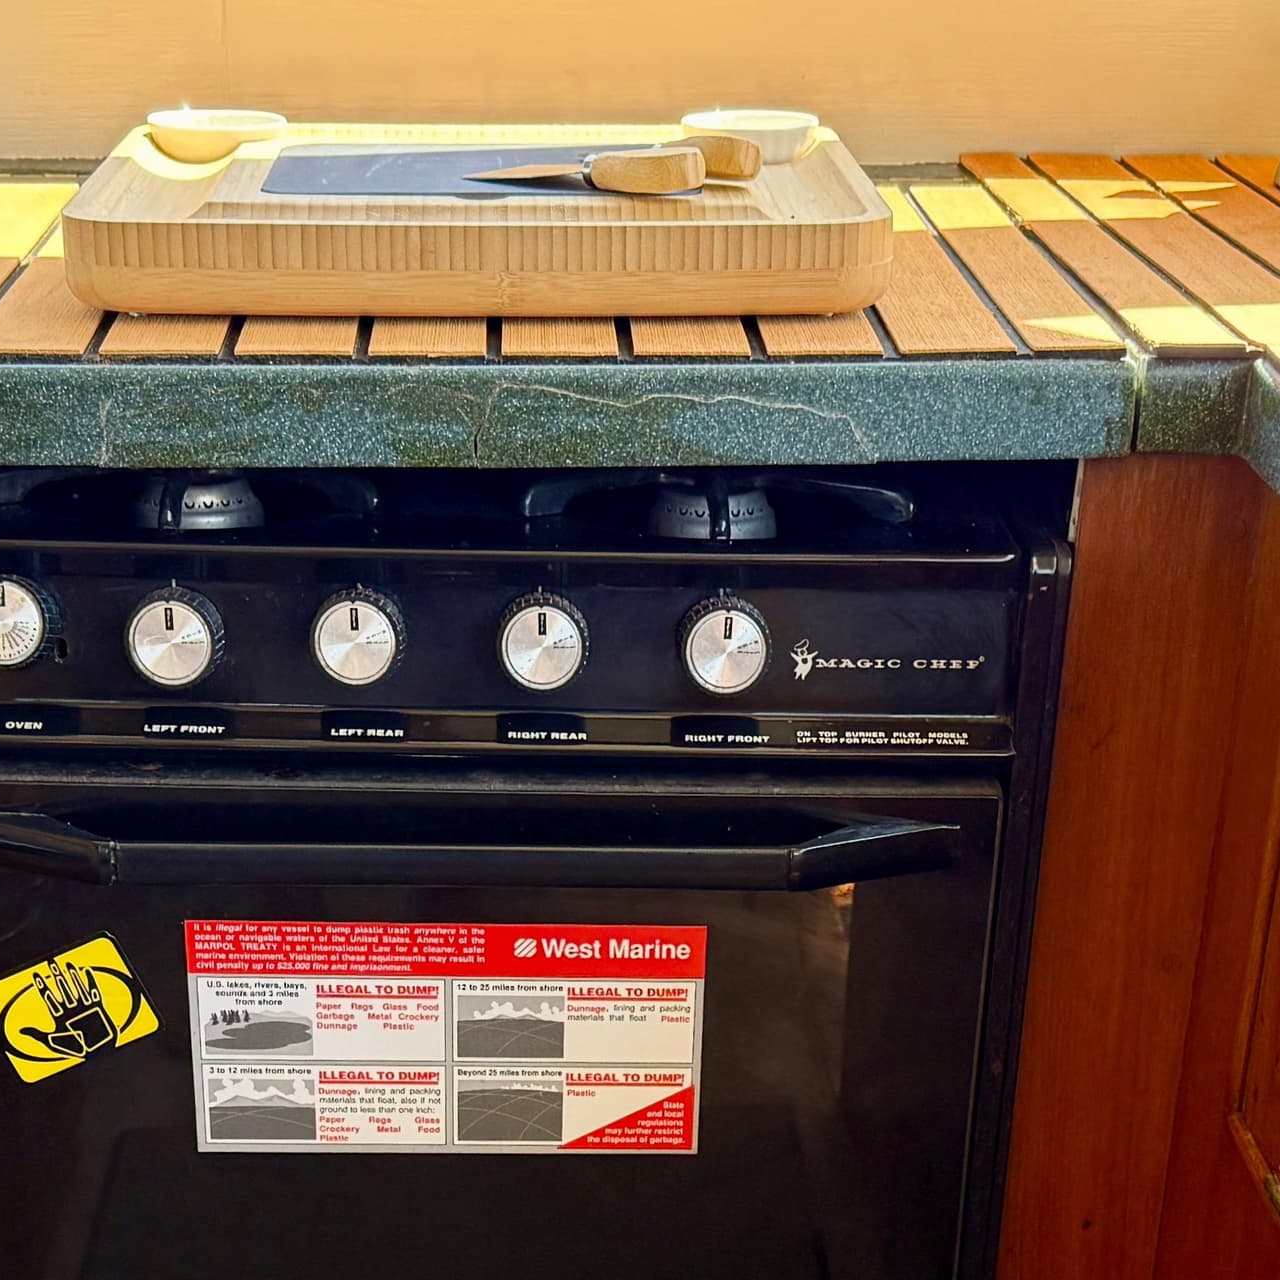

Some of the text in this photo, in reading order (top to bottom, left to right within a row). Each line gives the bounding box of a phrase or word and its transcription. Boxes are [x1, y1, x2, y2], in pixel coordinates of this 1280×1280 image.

[815, 658, 980, 670] MAGIC CHEF
[5, 721, 43, 730] OVEN
[144, 724, 225, 734] LEFT FRONT
[331, 728, 404, 737] LEFT REAR
[508, 731, 587, 740] RIGHT REAR
[684, 734, 770, 744] RIGHT FRONT
[262, 925, 278, 934] any
[280, 925, 310, 933] vessel
[326, 925, 351, 935] dump
[354, 926, 384, 935] plastic
[239, 933, 282, 943] navigable
[331, 934, 346, 943] the
[350, 935, 379, 944] United
[448, 936, 455, 944] V
[195, 942, 236, 951] MARPOL
[240, 942, 278, 951] TREATY
[311, 943, 368, 952] International
[372, 944, 391, 953] Law
[541, 938, 691, 960] West Marine
[195, 951, 227, 960] marine
[228, 952, 287, 961] environment.
[288, 952, 328, 961] Violation
[428, 956, 447, 964] may
[196, 960, 215, 969] civil
[216, 961, 249, 971] penalty
[252, 963, 263, 971] up
[316, 984, 439, 996] ILLEGAL TO DUMP!
[457, 983, 466, 992] 12
[469, 983, 478, 992] to
[492, 983, 515, 992] miles
[517, 984, 537, 992] from
[539, 984, 564, 992] shore
[567, 987, 689, 998] ILLEGAL TO DUMP!
[276, 990, 300, 998] miles
[235, 998, 283, 1006] from shore
[316, 1002, 342, 1012] Paper
[382, 1002, 408, 1011] Glass
[416, 1002, 439, 1012] Food
[567, 1004, 609, 1014] Dunnage,
[640, 1004, 656, 1013] and
[659, 1005, 691, 1014] packing
[316, 1012, 439, 1023] Garbage Metal Crockery
[567, 1013, 605, 1022] materials
[660, 1015, 690, 1024] Plastic
[316, 1022, 415, 1031] Dunnage Plastic
[216, 1067, 225, 1075] to
[227, 1067, 238, 1075] 12
[239, 1066, 262, 1075] miles
[264, 1067, 285, 1075] from
[287, 1067, 312, 1075] shore
[457, 1069, 487, 1077] Beyond
[521, 1069, 539, 1077] from
[541, 1069, 563, 1077] shore
[318, 1071, 440, 1081] ILLEGAL TO DUMP!
[566, 1073, 685, 1083] ILLEGAL TO DUMP!
[318, 1087, 441, 1097] Dunnage, lining and packing
[567, 1089, 596, 1097] Plastic
[359, 1096, 374, 1105] that
[400, 1096, 418, 1105] also
[319, 1106, 348, 1115] ground
[350, 1106, 359, 1114] to
[378, 1106, 396, 1114] than
[319, 1115, 346, 1125] Paper
[414, 1116, 440, 1124] Glass
[637, 1118, 684, 1127] regulations
[319, 1125, 441, 1135] Crockery Metal Food
[602, 1135, 638, 1145] disposal
